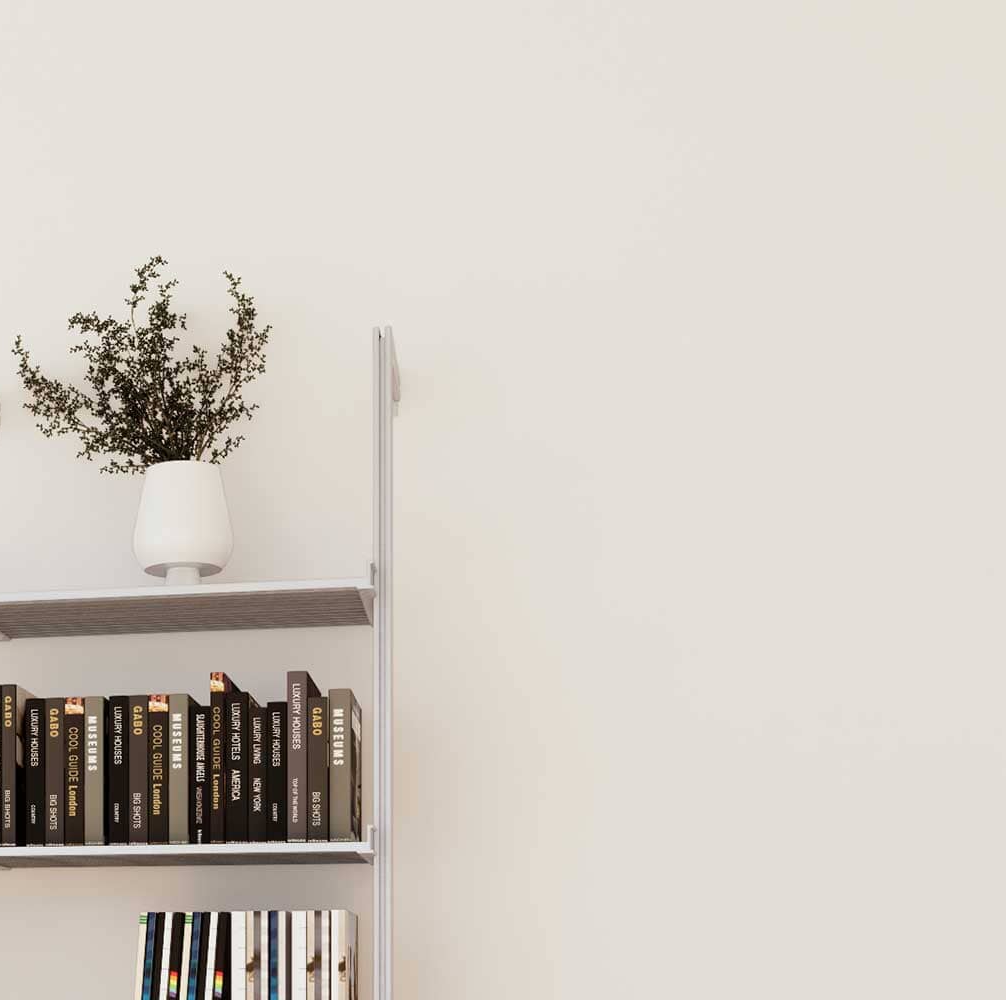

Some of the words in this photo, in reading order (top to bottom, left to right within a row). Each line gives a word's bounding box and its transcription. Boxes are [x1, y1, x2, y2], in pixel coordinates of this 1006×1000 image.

[4, 696, 12, 728] GABO
[292, 684, 301, 715] LUXURY
[30, 708, 39, 736] LUXURY
[50, 708, 58, 738] GABO
[114, 706, 122, 734] LUXURY
[133, 706, 142, 736] GABO
[212, 706, 220, 734] COOL
[231, 702, 240, 731] LUXURY
[252, 717, 261, 742] LUXURY
[272, 712, 280, 738] LUXURY
[312, 707, 322, 736] GABO
[68, 726, 78, 752] COOL
[88, 716, 98, 772] MUSEUMS
[152, 724, 162, 750] COOL
[172, 714, 182, 769] MUSEUMS
[231, 732, 240, 760] HOTELS
[292, 716, 301, 750] HOUSES
[332, 708, 344, 766] MUSEUMS
[30, 738, 39, 767] HOUSES
[114, 736, 122, 765] HOUSES
[212, 738, 220, 770] GUIDE
[252, 744, 261, 764] LIVING
[272, 740, 280, 767] HOUSES
[68, 754, 78, 782] GUIDE
[152, 753, 162, 780] GUIDE
[196, 762, 205, 782] ANGELS
[132, 792, 141, 805] BIG
[212, 774, 220, 810] London
[231, 769, 240, 801] AMERICA
[252, 778, 261, 792] NEW
[312, 791, 321, 803] BIG
[68, 785, 78, 816] London
[152, 783, 162, 816] London
[252, 794, 261, 812] YORK
[132, 806, 141, 828] SHOTS
[312, 804, 321, 826] SHOTS
